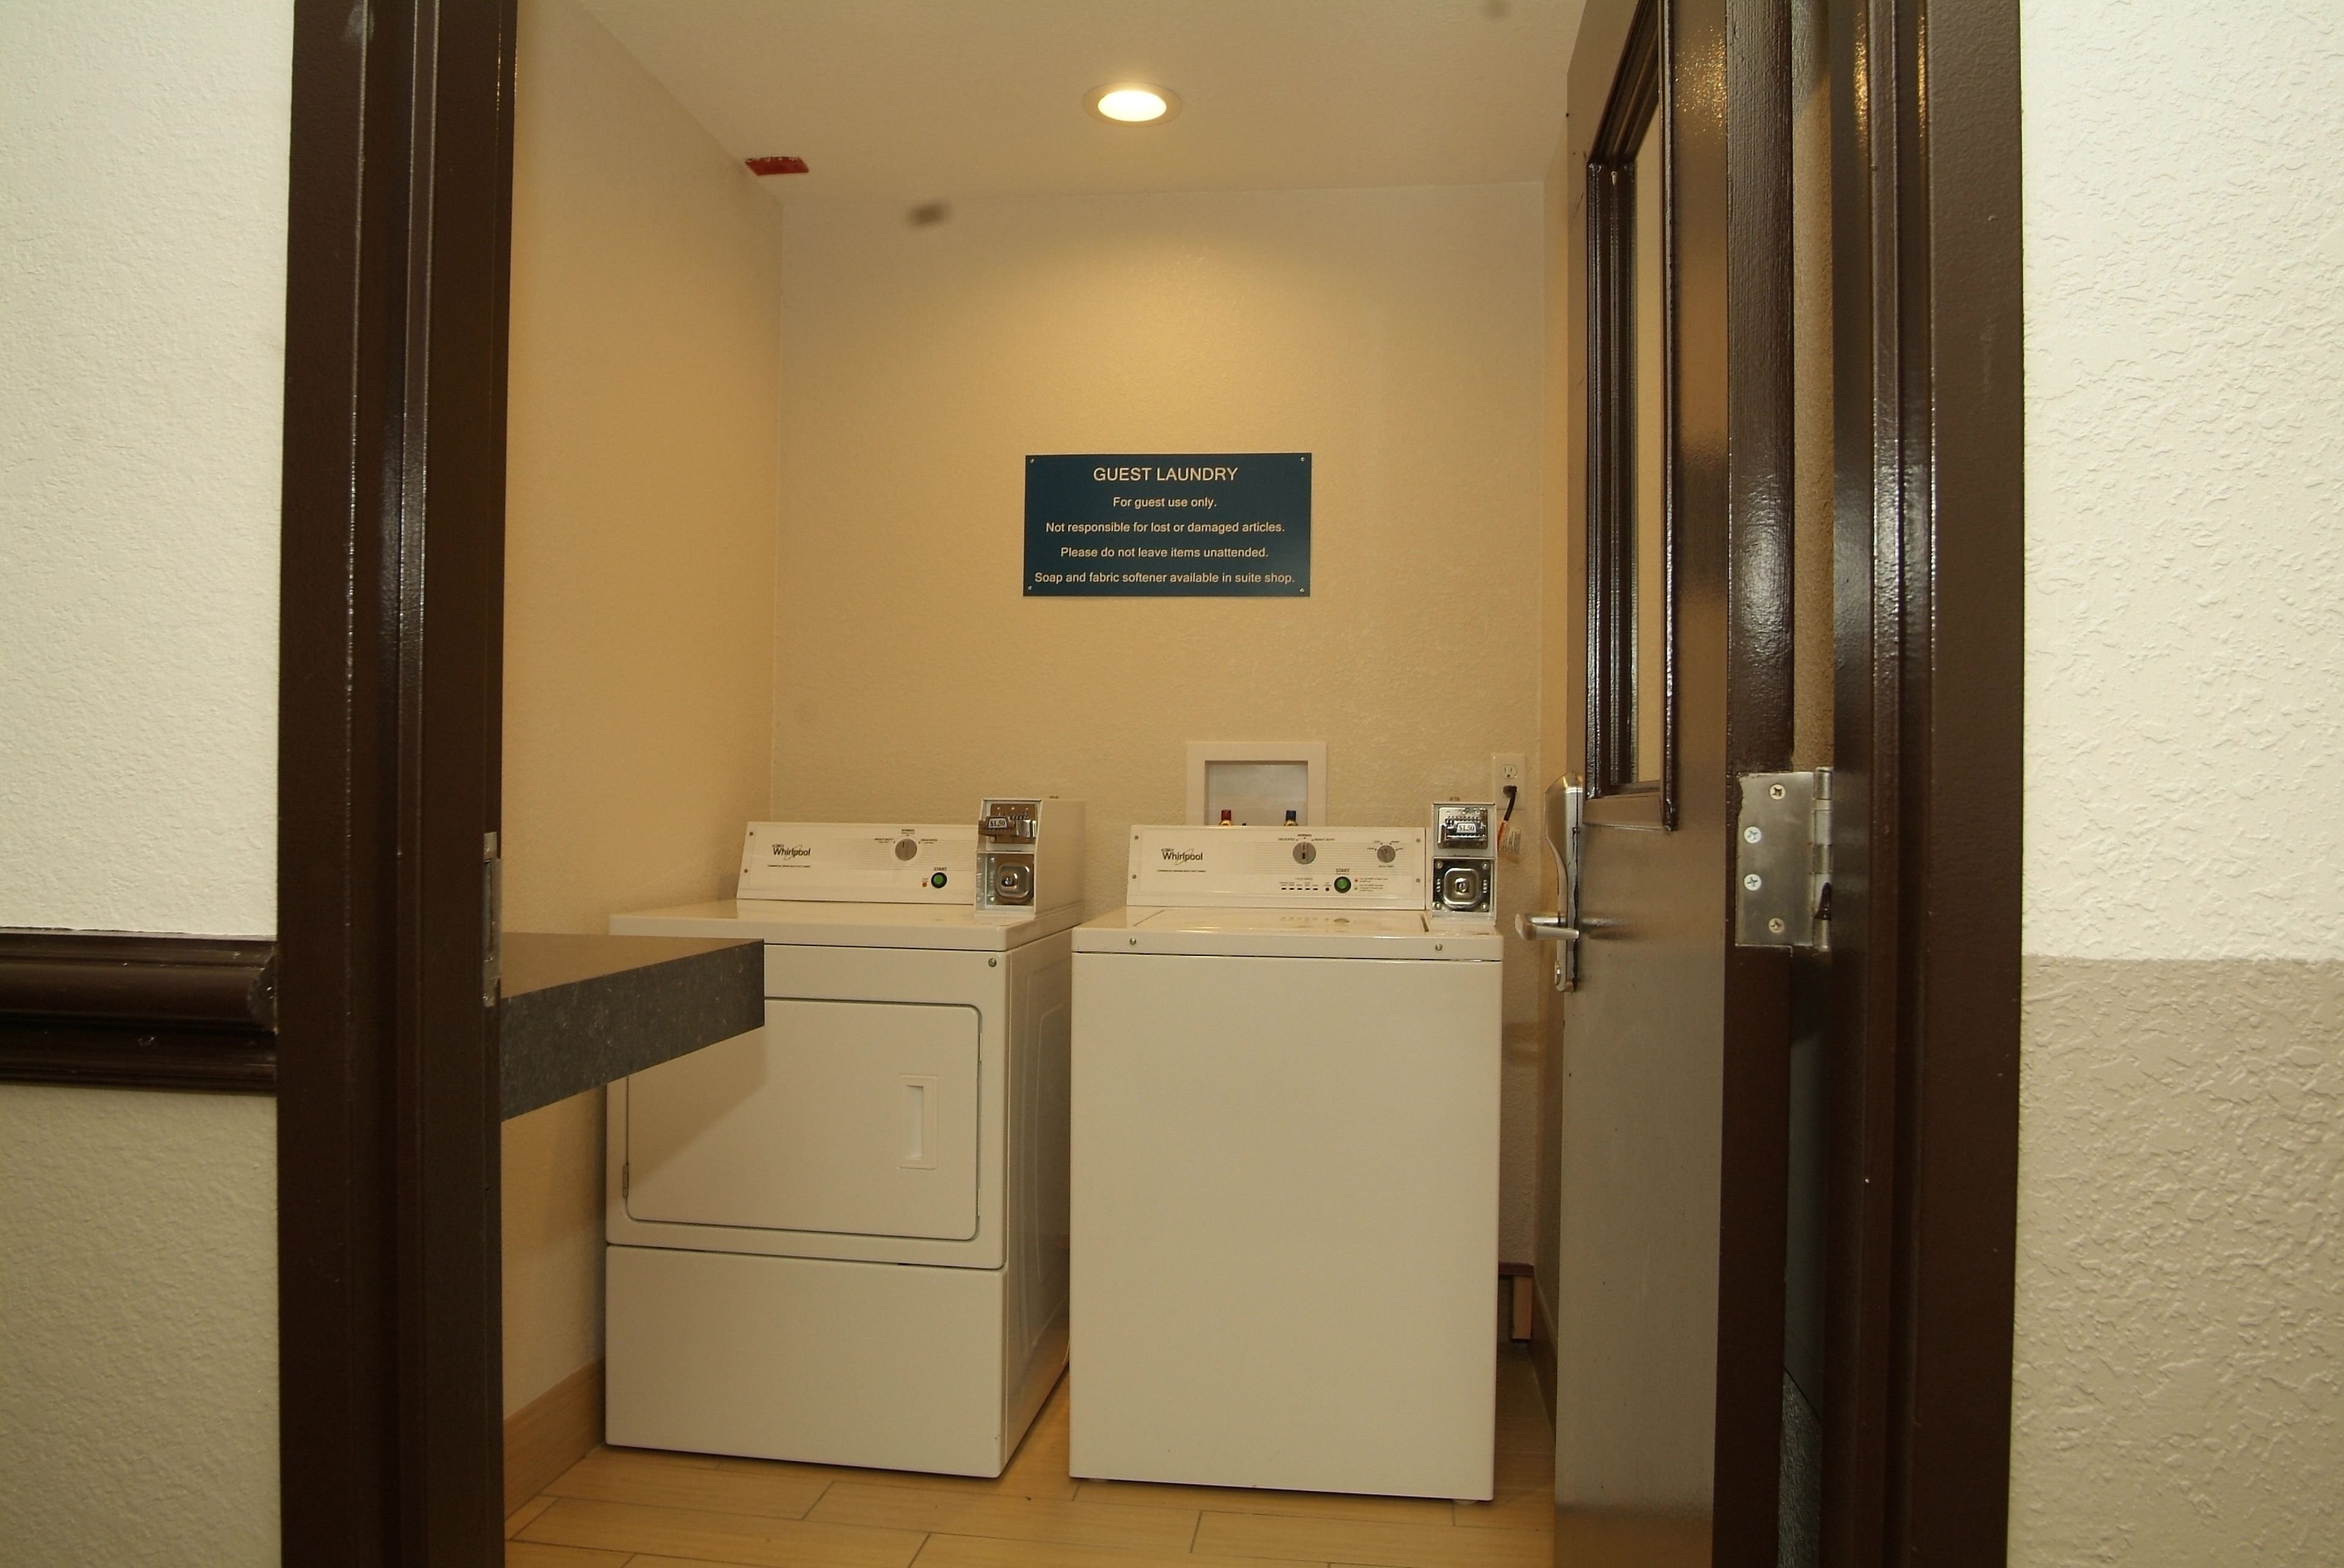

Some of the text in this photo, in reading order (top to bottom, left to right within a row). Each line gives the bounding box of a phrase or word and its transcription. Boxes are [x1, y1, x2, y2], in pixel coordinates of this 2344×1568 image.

[1093, 466, 1239, 482] GUEST LAUNDRY
[1113, 496, 1217, 510] For guest use only.
[1045, 521, 1286, 535] Not responsible for lost or damaged articles.
[1060, 547, 1269, 558] Please do not leave items unattended.
[1034, 572, 1295, 585] Soap and fabric softener available in suite shop.
[773, 847, 811, 858] Whirlpool
[1162, 851, 1203, 862] Whirlpool
